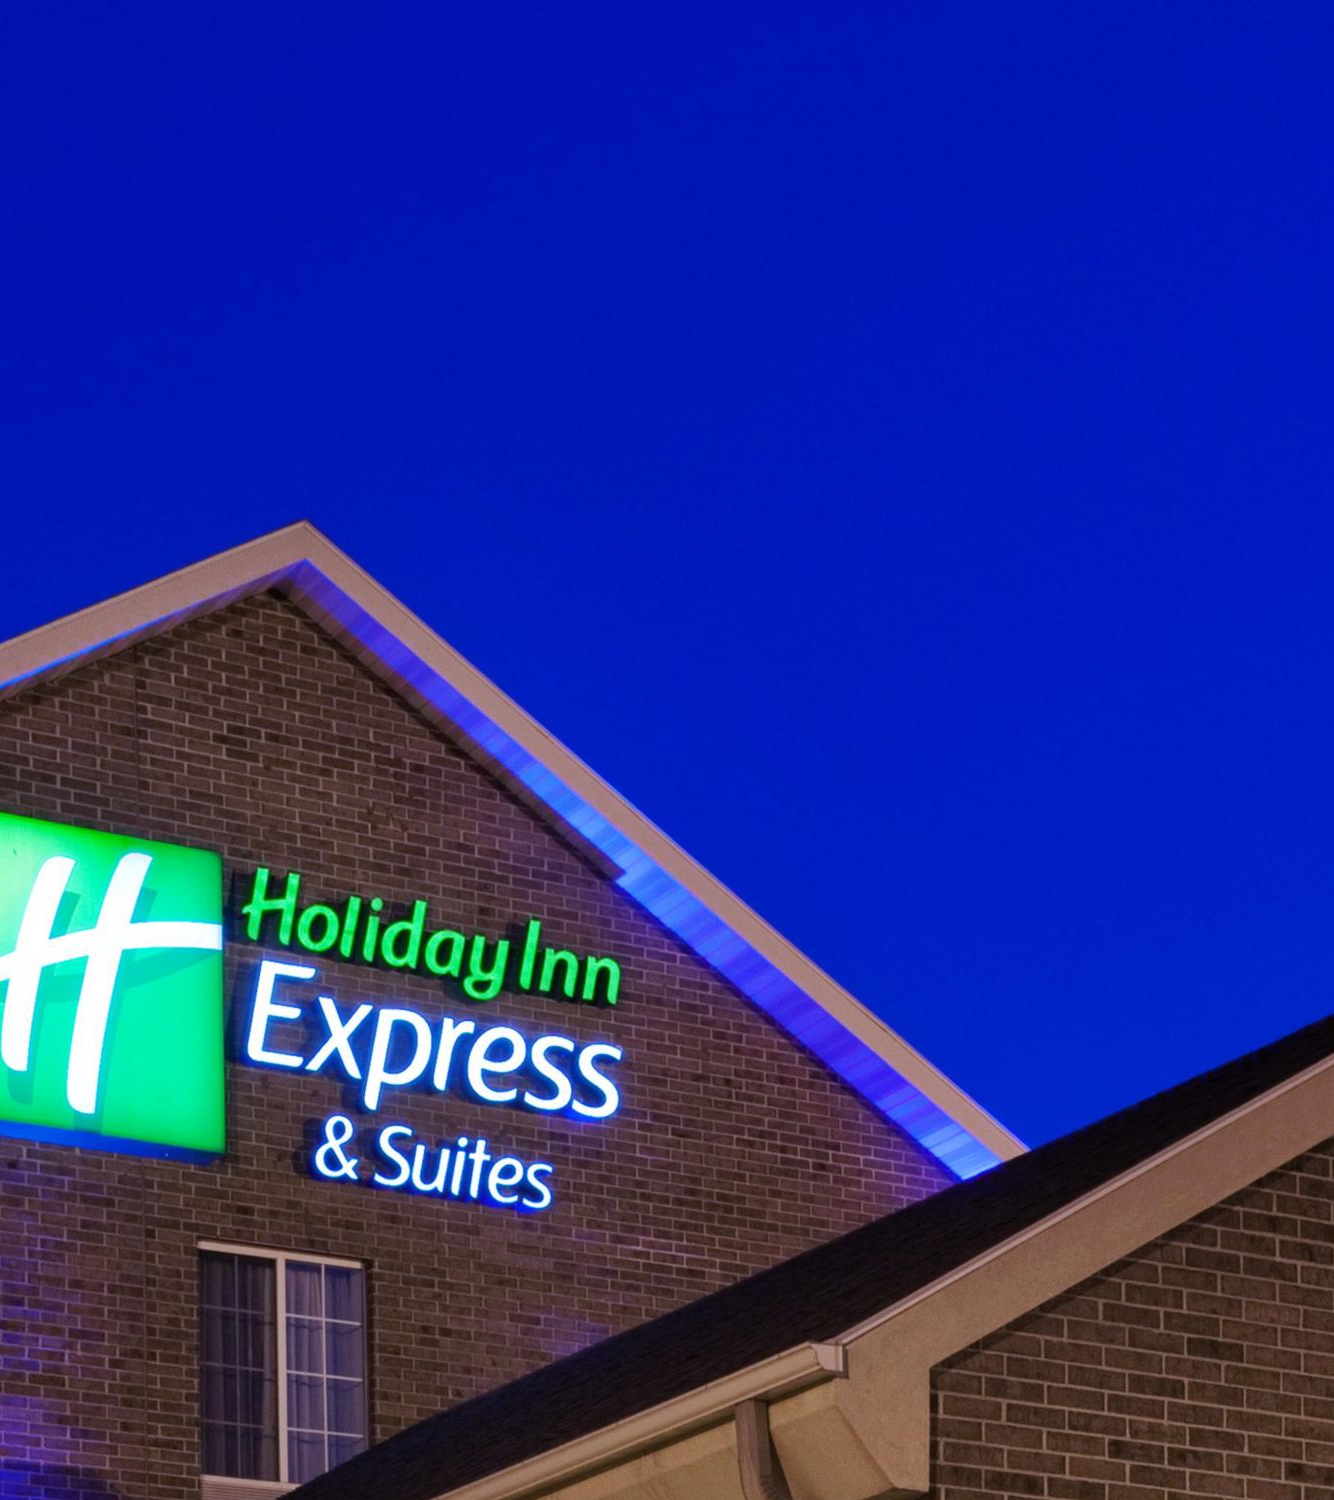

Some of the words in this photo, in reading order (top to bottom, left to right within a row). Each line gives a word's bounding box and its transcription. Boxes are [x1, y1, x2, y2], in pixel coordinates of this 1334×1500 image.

[242, 866, 511, 1001] Holiday
[518, 918, 622, 1005] Inn
[246, 959, 623, 1119] Express
[314, 1114, 359, 1180] &
[373, 1124, 554, 1210] Suites
